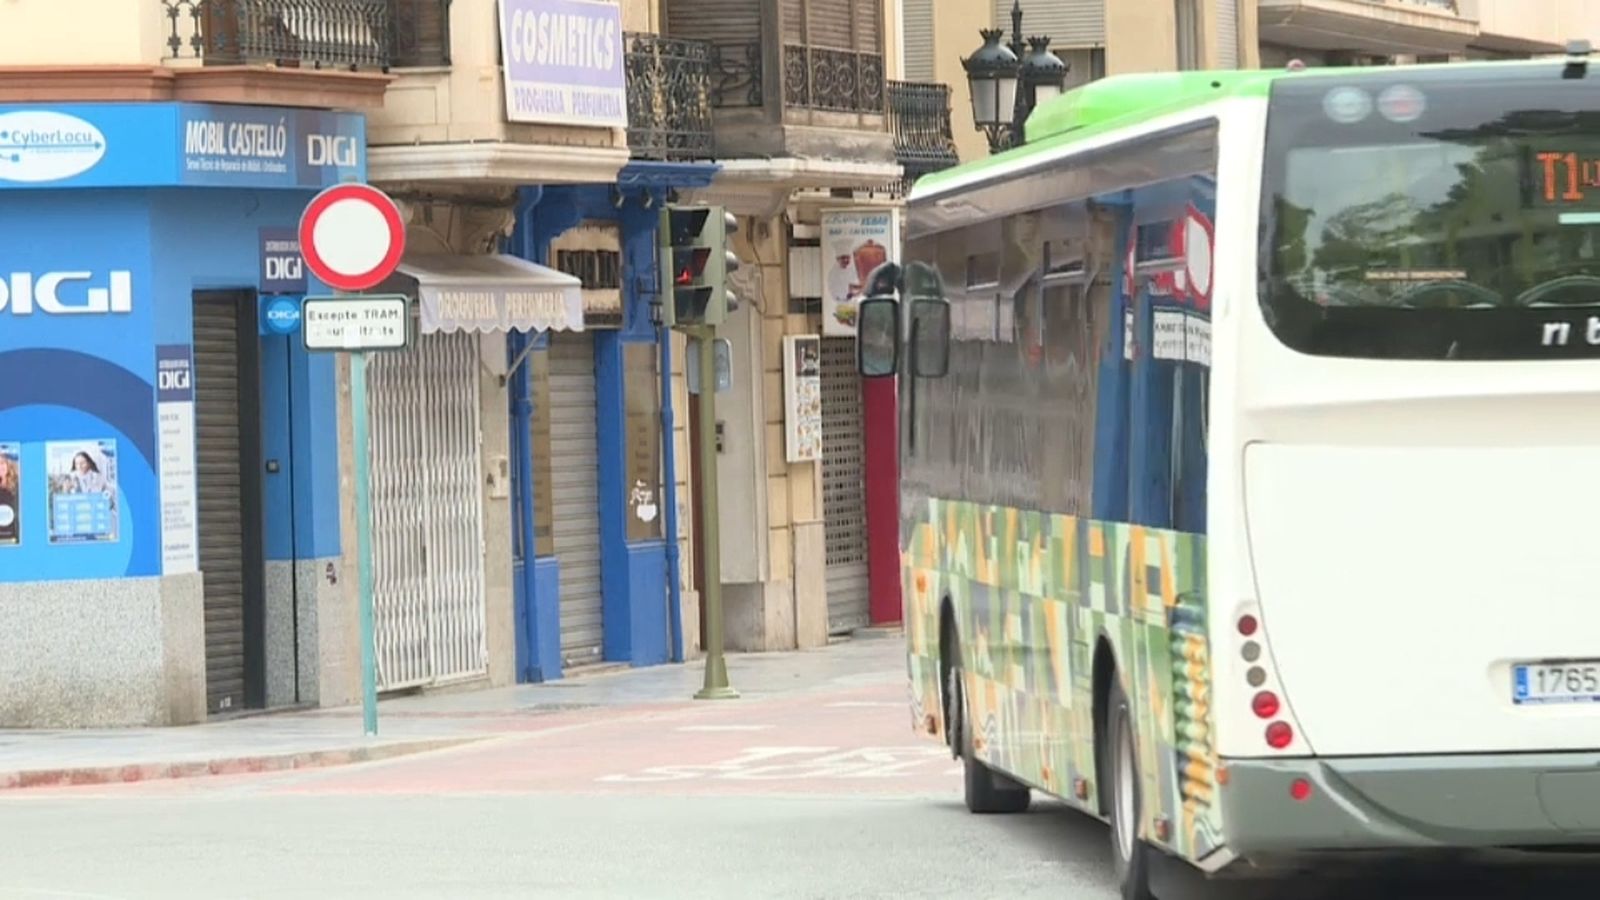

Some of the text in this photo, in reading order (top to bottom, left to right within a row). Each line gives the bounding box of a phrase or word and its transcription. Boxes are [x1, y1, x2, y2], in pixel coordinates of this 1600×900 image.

[511, 8, 614, 71] COSMETICS
[11, 129, 93, 150] CyberLocu
[186, 116, 287, 158] MOBIL CASTELLÓ
[307, 133, 358, 167] DIGI
[1536, 151, 1584, 200] T1
[266, 257, 302, 280] DIGI
[0, 270, 132, 314] IGI
[308, 310, 358, 322] Excepte
[159, 369, 190, 390] DIGI
[1537, 667, 1597, 692] 1765
